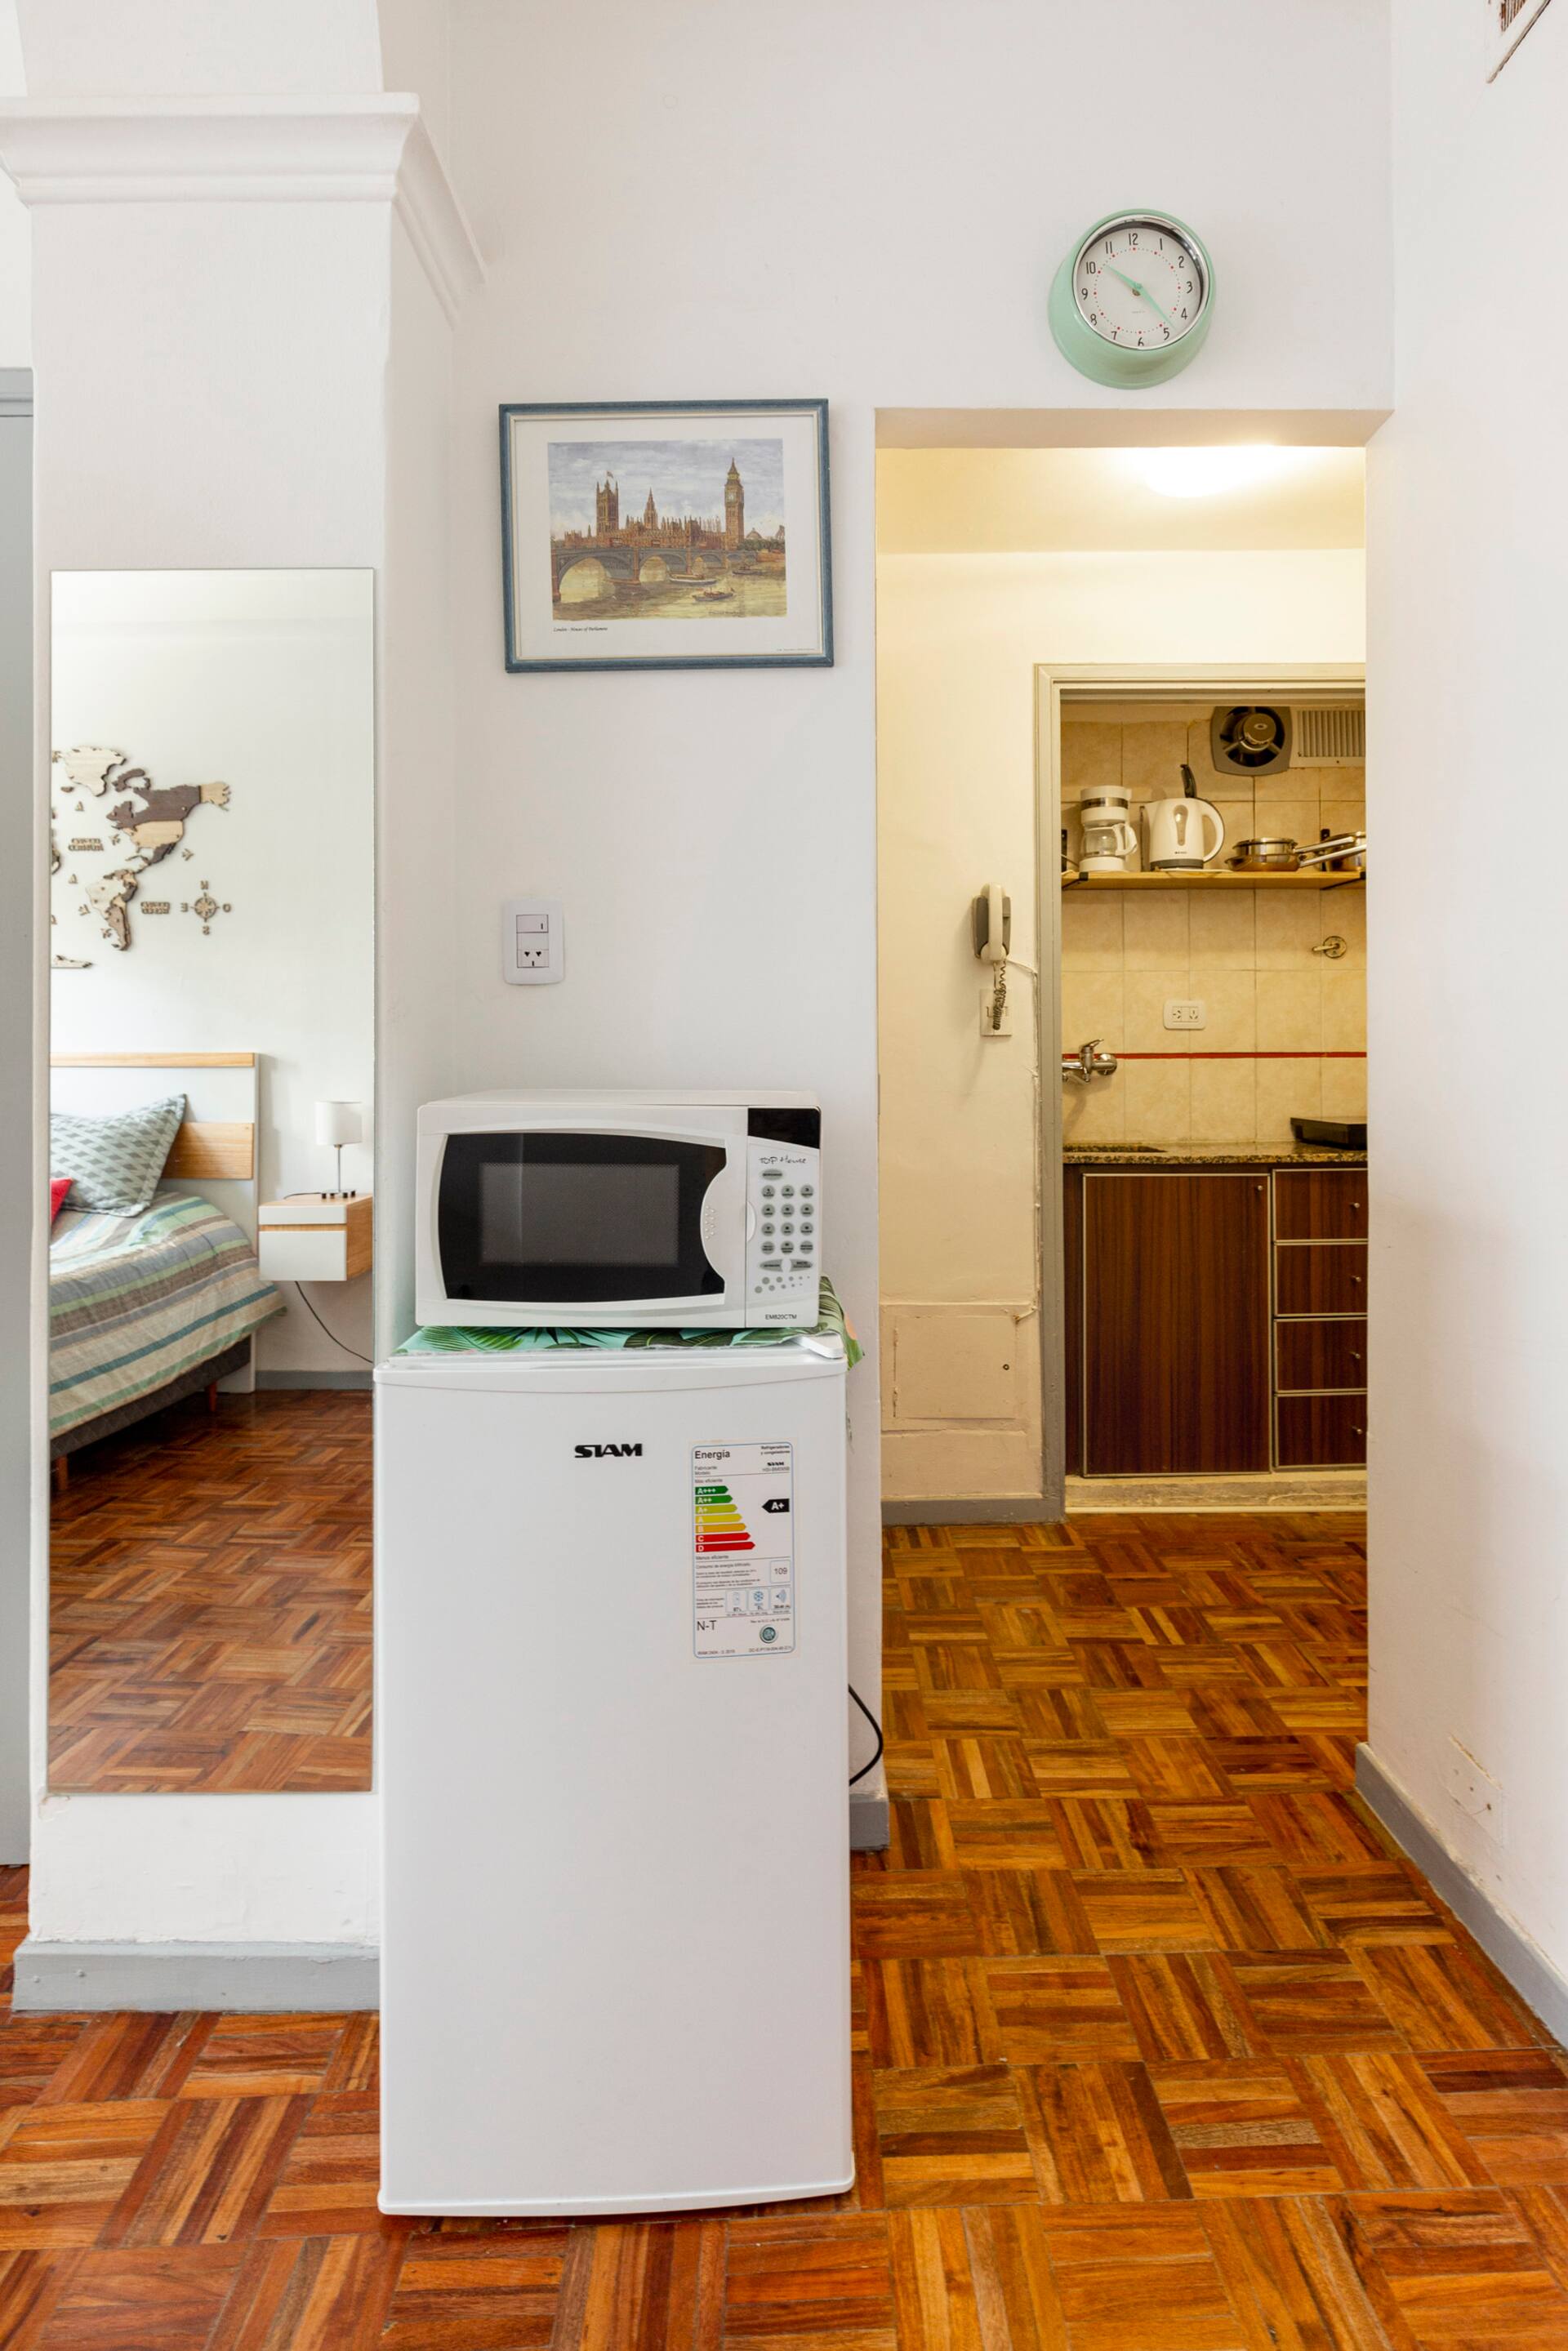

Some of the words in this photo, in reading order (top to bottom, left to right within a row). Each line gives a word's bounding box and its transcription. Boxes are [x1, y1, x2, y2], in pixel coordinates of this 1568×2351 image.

[1128, 233, 1138, 246] 12
[1105, 241, 1112, 255] 11
[1085, 261, 1096, 274] 10
[1178, 256, 1185, 269] 2
[1081, 287, 1089, 301] 9
[1186, 281, 1193, 294] 3
[1089, 313, 1098, 326] 8
[1180, 307, 1188, 320] 4
[1110, 331, 1118, 341] 7
[1163, 327, 1170, 341] 5
[1138, 336, 1144, 347] 6
[760, 1155, 778, 1164] TOP
[780, 1153, 807, 1164] House
[574, 1443, 643, 1458] SIAM
[771, 1502, 784, 1511] A+
[773, 1567, 788, 1575] 109
[697, 1620, 717, 1631] N-T
